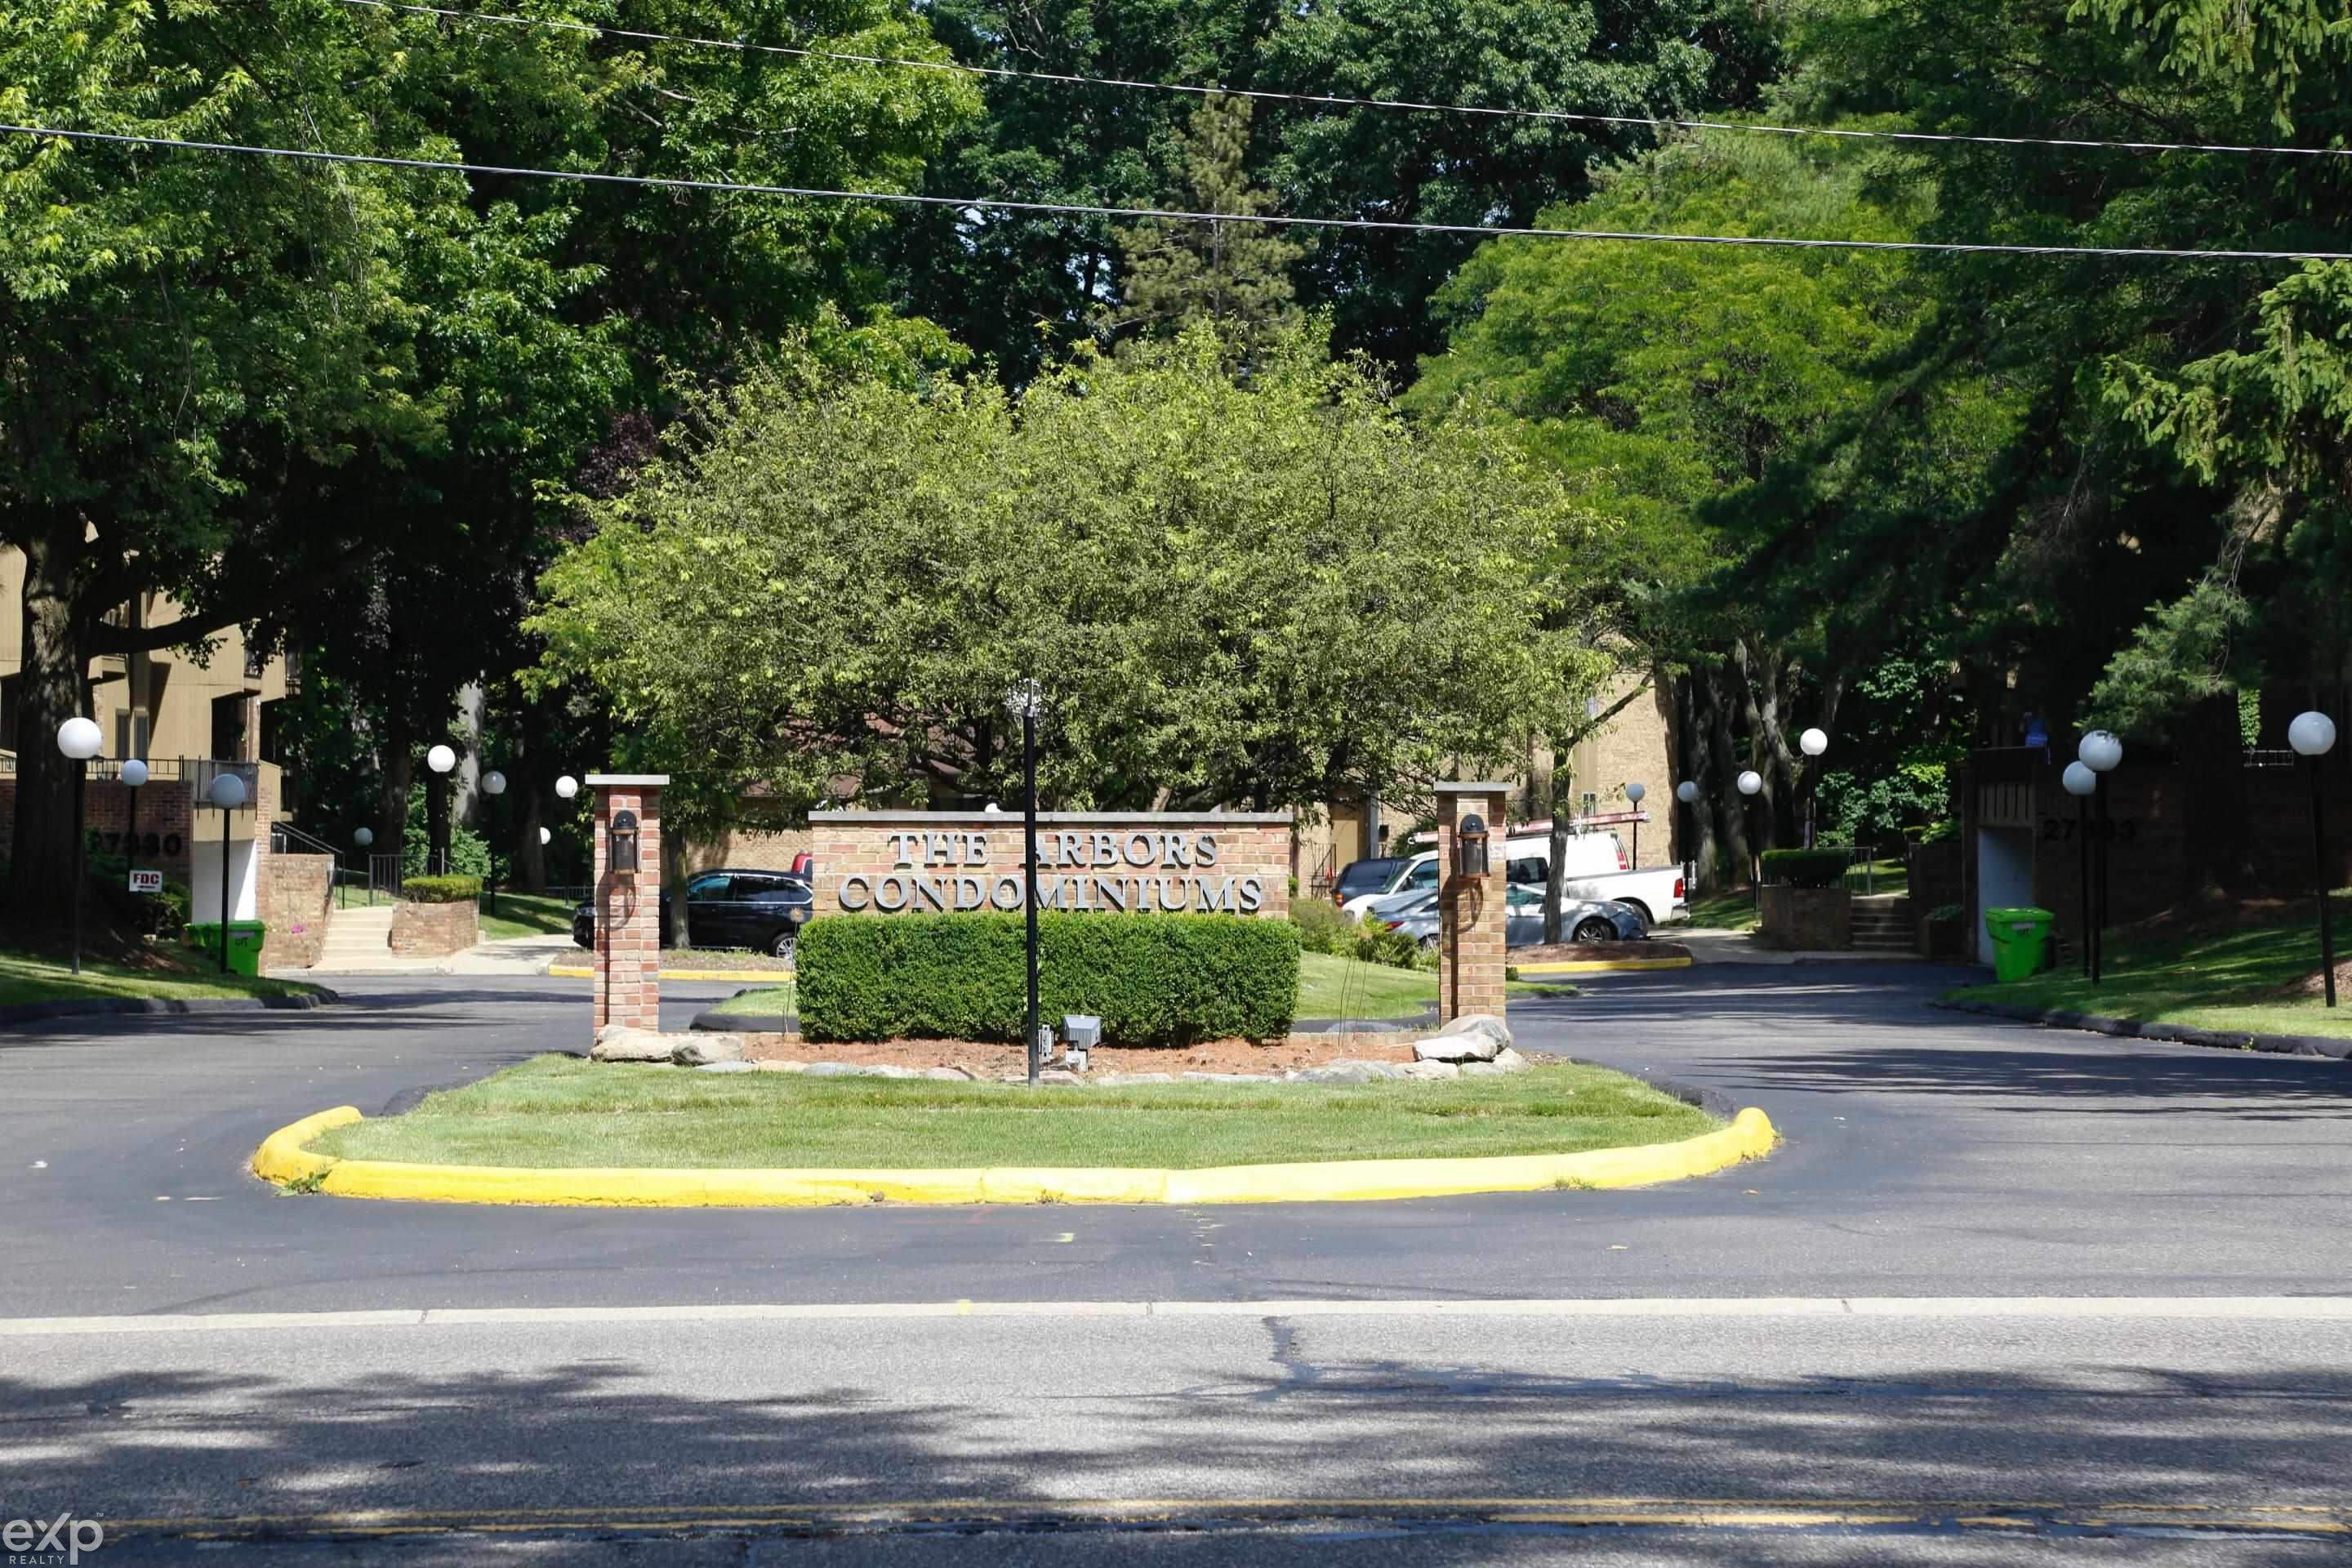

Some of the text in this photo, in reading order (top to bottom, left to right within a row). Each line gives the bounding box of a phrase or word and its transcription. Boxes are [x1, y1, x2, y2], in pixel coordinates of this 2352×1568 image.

[888, 832, 989, 867] THE
[133, 873, 159, 884] FDC
[839, 875, 1262, 913] CONDOMINIUMS
